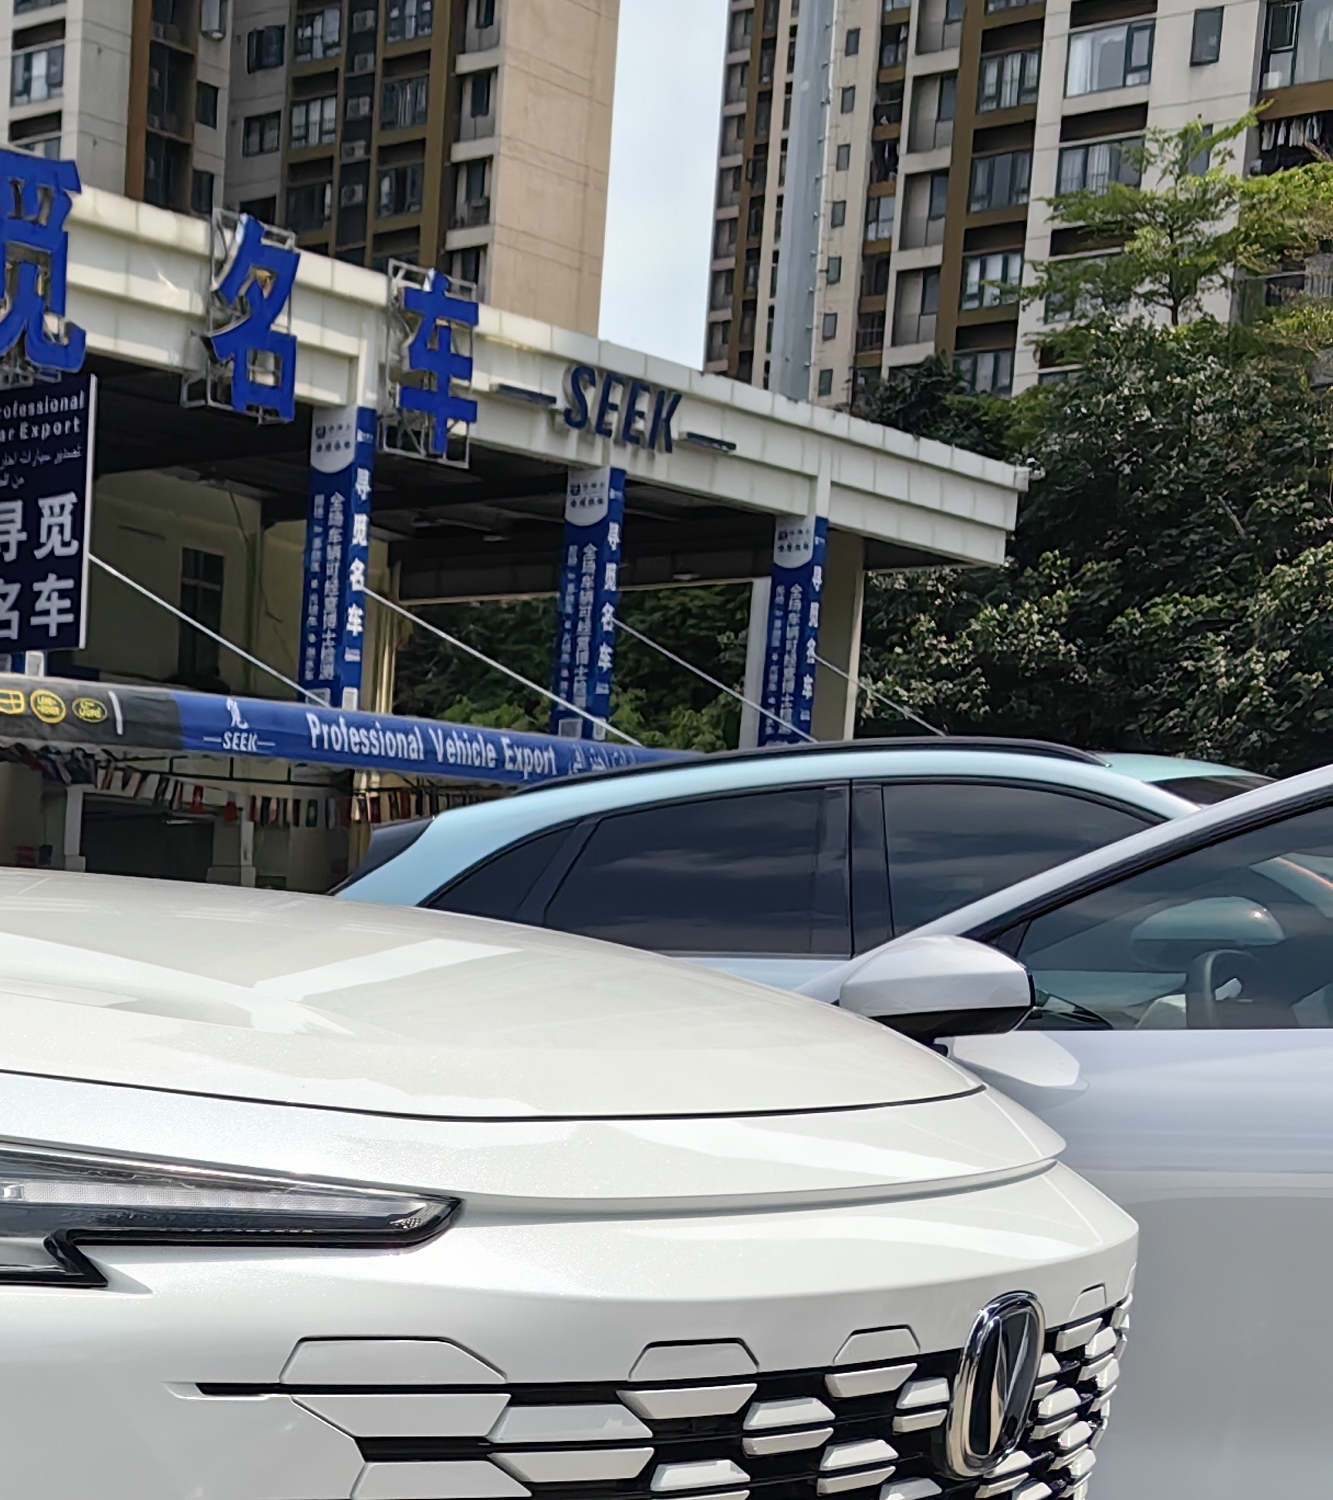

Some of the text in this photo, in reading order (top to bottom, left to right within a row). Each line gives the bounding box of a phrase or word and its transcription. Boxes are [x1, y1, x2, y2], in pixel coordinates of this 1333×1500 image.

[19, 416, 81, 441] Export
[564, 366, 683, 454] SEEK
[222, 731, 258, 752] SEEK
[306, 712, 424, 762] Professional
[429, 727, 498, 769] Vehicle
[502, 737, 558, 781] Export
